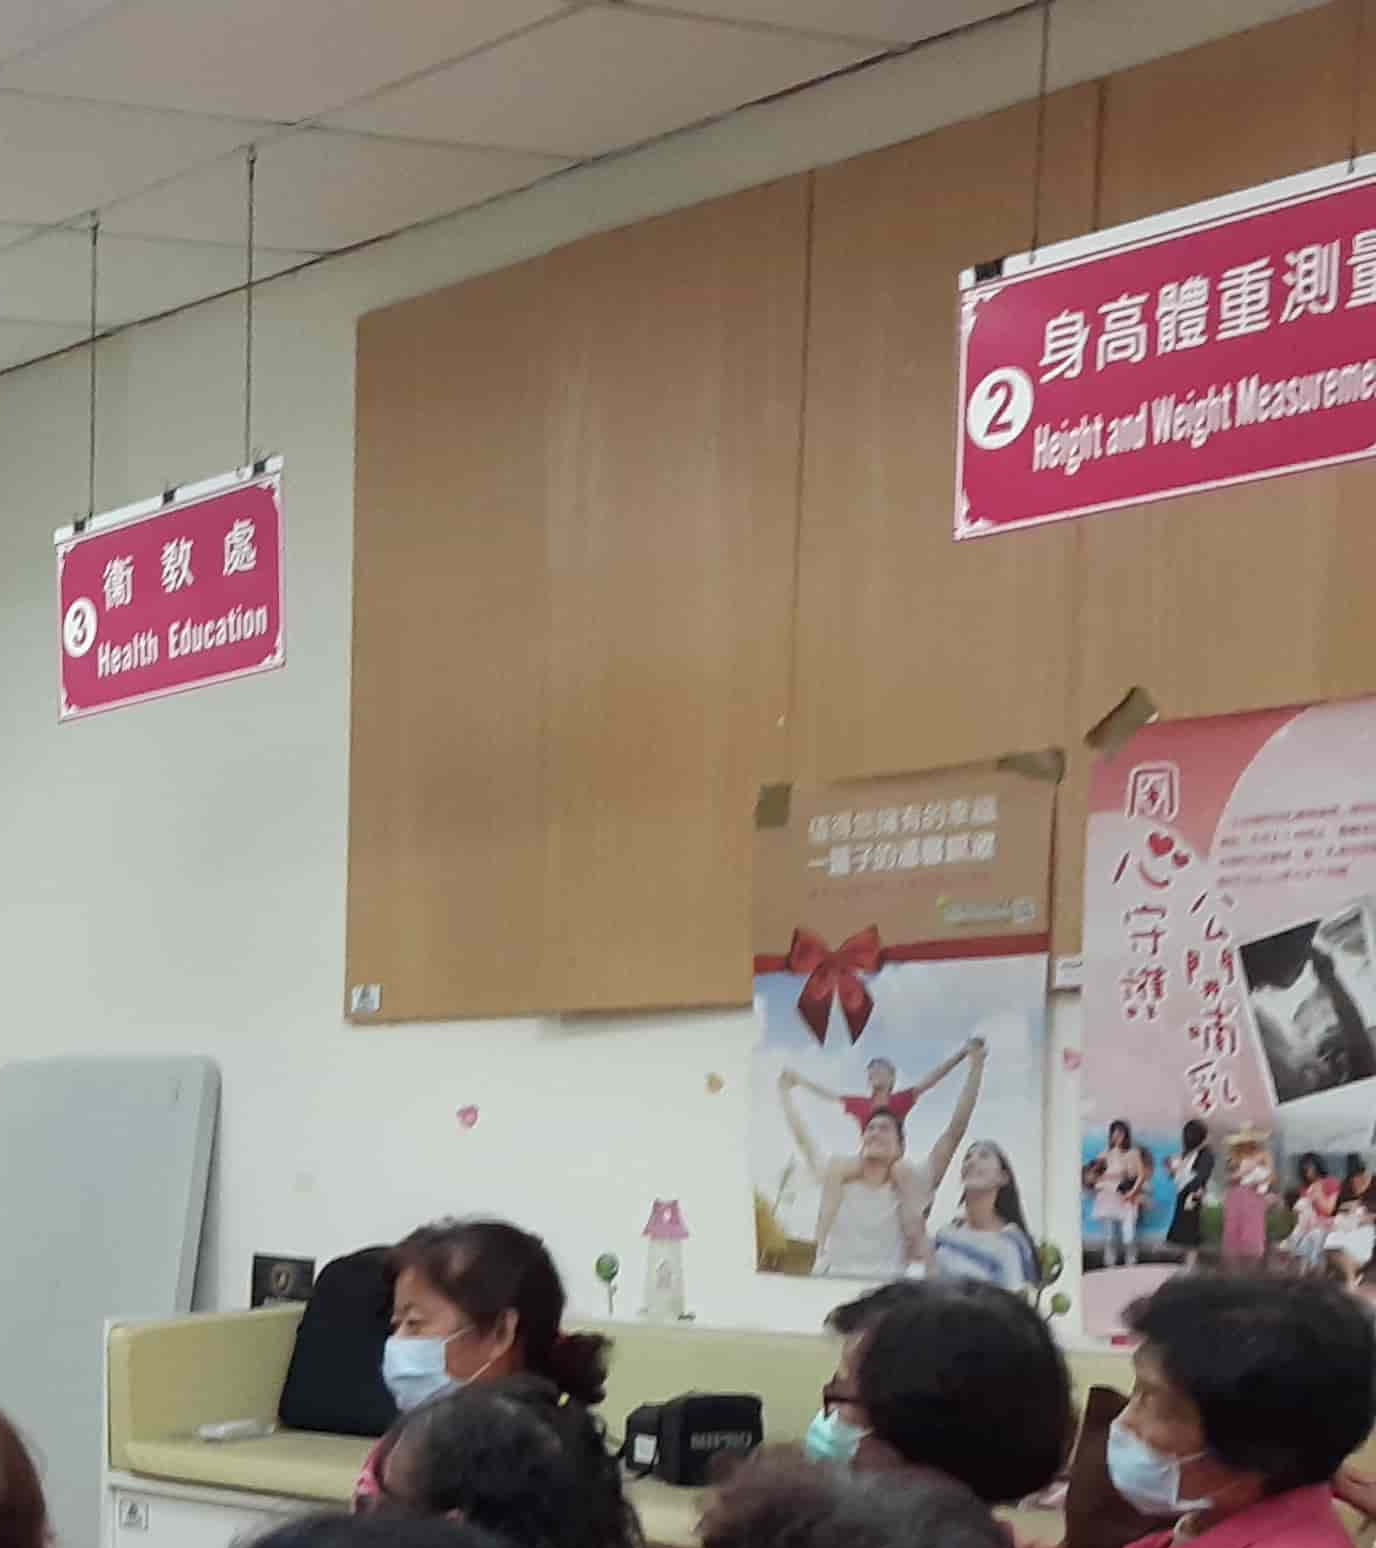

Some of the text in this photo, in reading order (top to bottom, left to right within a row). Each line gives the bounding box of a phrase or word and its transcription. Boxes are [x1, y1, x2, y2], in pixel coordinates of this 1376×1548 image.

[1032, 414, 1103, 476] Height
[1106, 402, 1148, 454] and
[1151, 382, 1233, 449] Weight
[98, 604, 268, 679] Health Education
